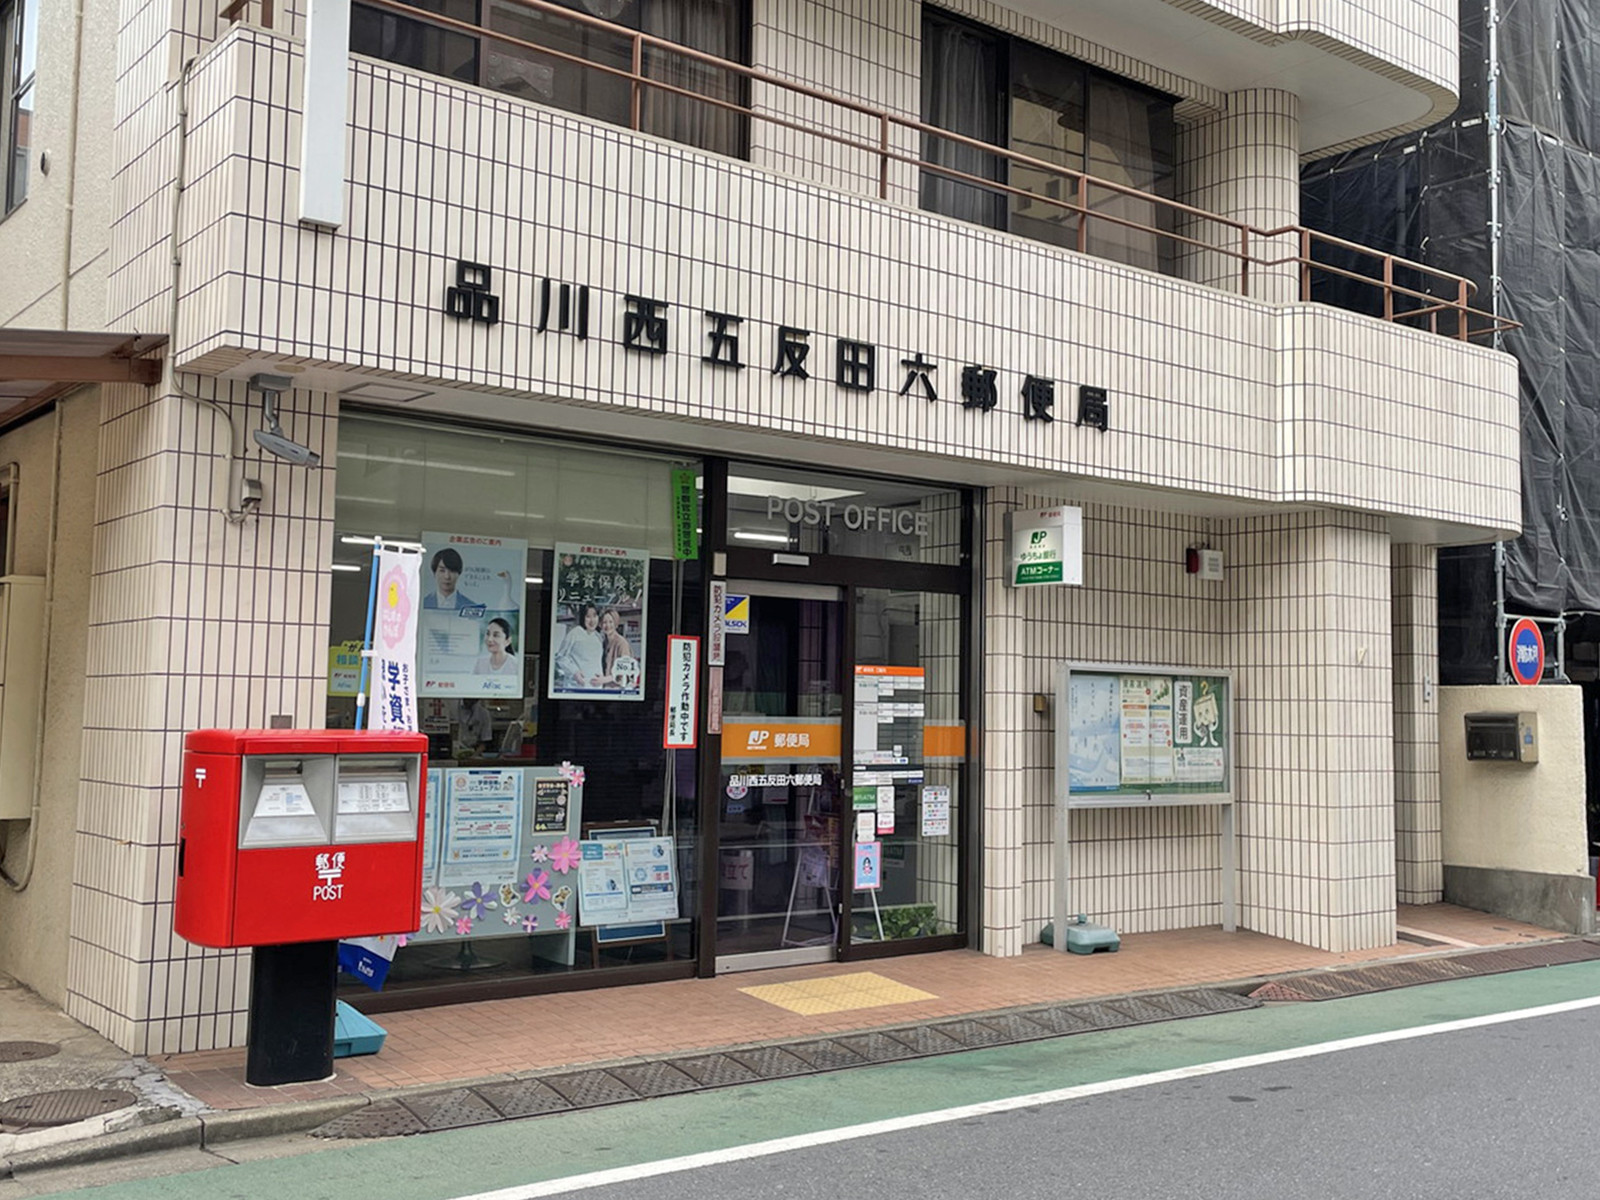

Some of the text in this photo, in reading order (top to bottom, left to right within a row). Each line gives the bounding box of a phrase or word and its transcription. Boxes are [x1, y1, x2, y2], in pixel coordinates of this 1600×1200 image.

[446, 259, 1109, 434] 品川西五反田六郵便局
[767, 495, 929, 535] POST OFFICE
[1031, 531, 1047, 544] JP
[1020, 550, 1056, 561] ゆうちょ銀行
[1021, 565, 1060, 576] ATMコーナー
[679, 642, 691, 742] 防犯カメラ作動中です
[1178, 684, 1188, 740] 資産運用
[774, 733, 810, 748] 郵便局
[729, 774, 822, 787] 品川西五反田六郵便局
[315, 852, 346, 871] 郵便
[312, 884, 344, 901] POST
